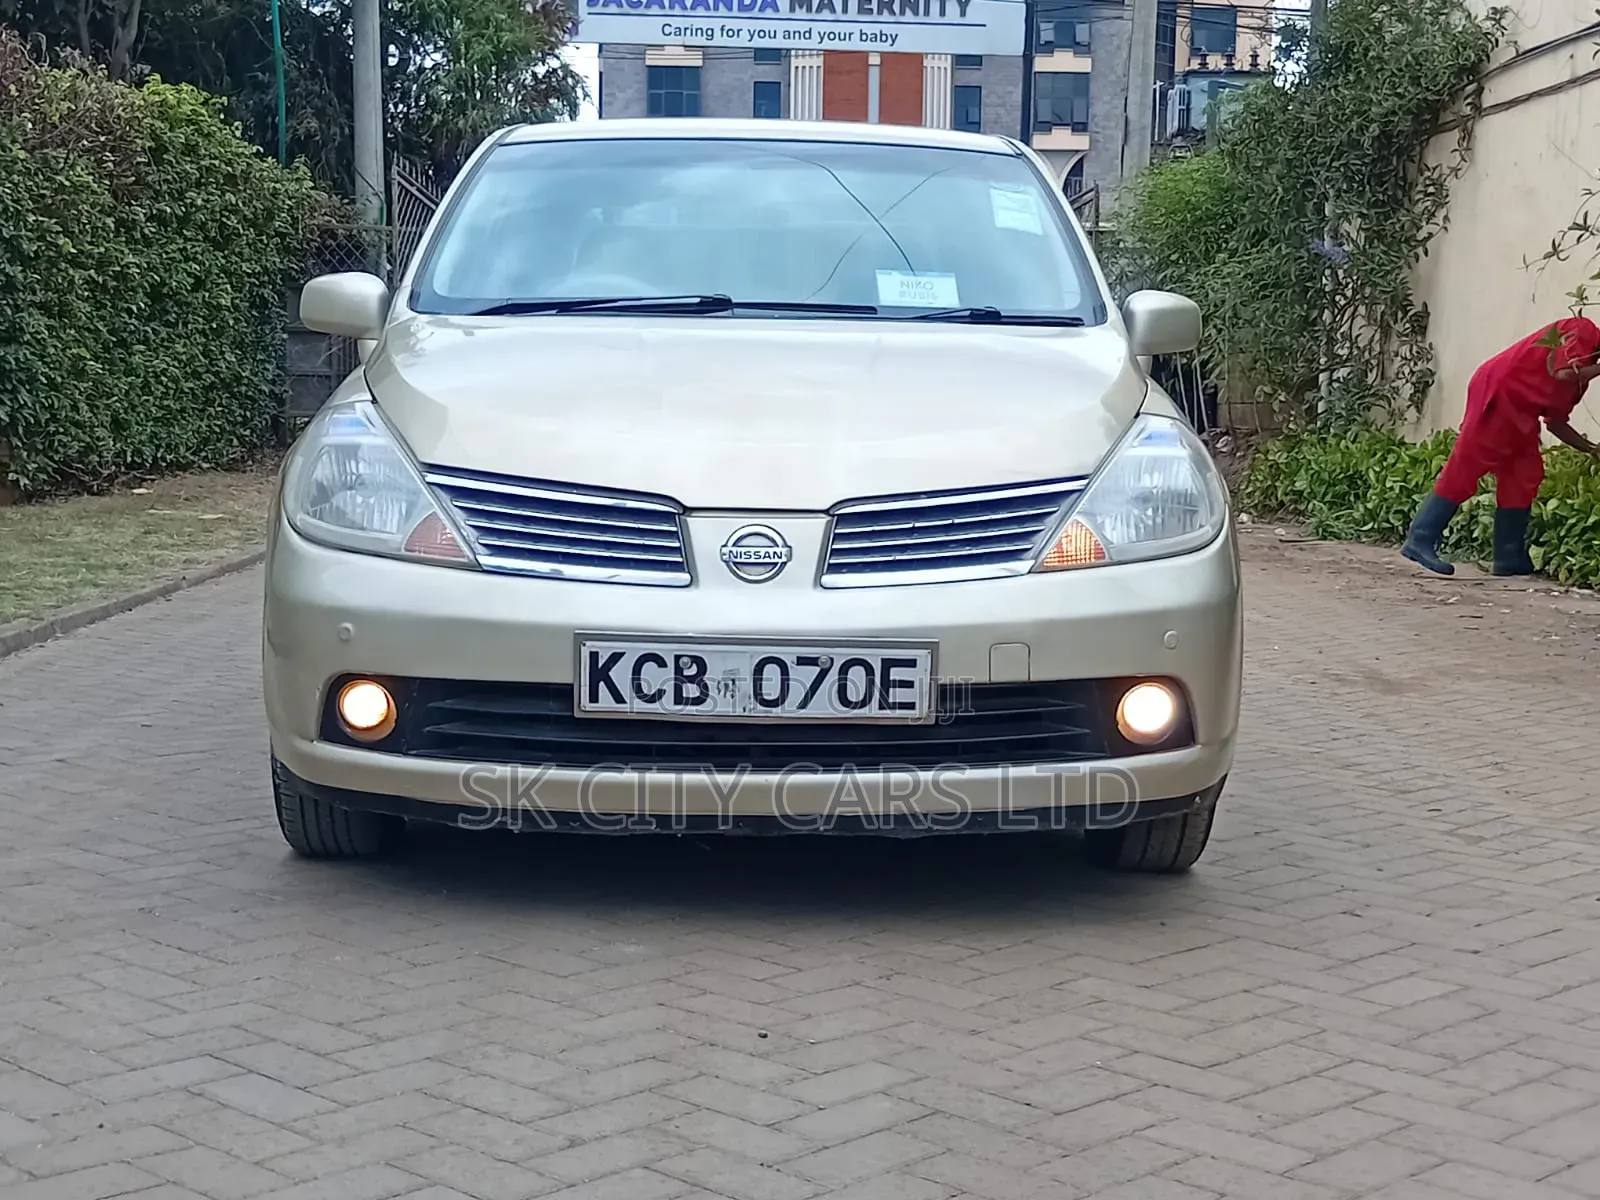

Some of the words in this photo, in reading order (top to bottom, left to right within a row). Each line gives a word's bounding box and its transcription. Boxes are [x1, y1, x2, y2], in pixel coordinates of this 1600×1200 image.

[661, 23, 714, 40] Caring
[720, 24, 743, 38] for
[747, 28, 777, 42] you
[782, 27, 812, 40] and
[817, 29, 855, 44] your
[859, 29, 899, 46] baby
[728, 549, 783, 560] NISSAN
[588, 650, 709, 706] KCB
[752, 655, 918, 711] 070E
